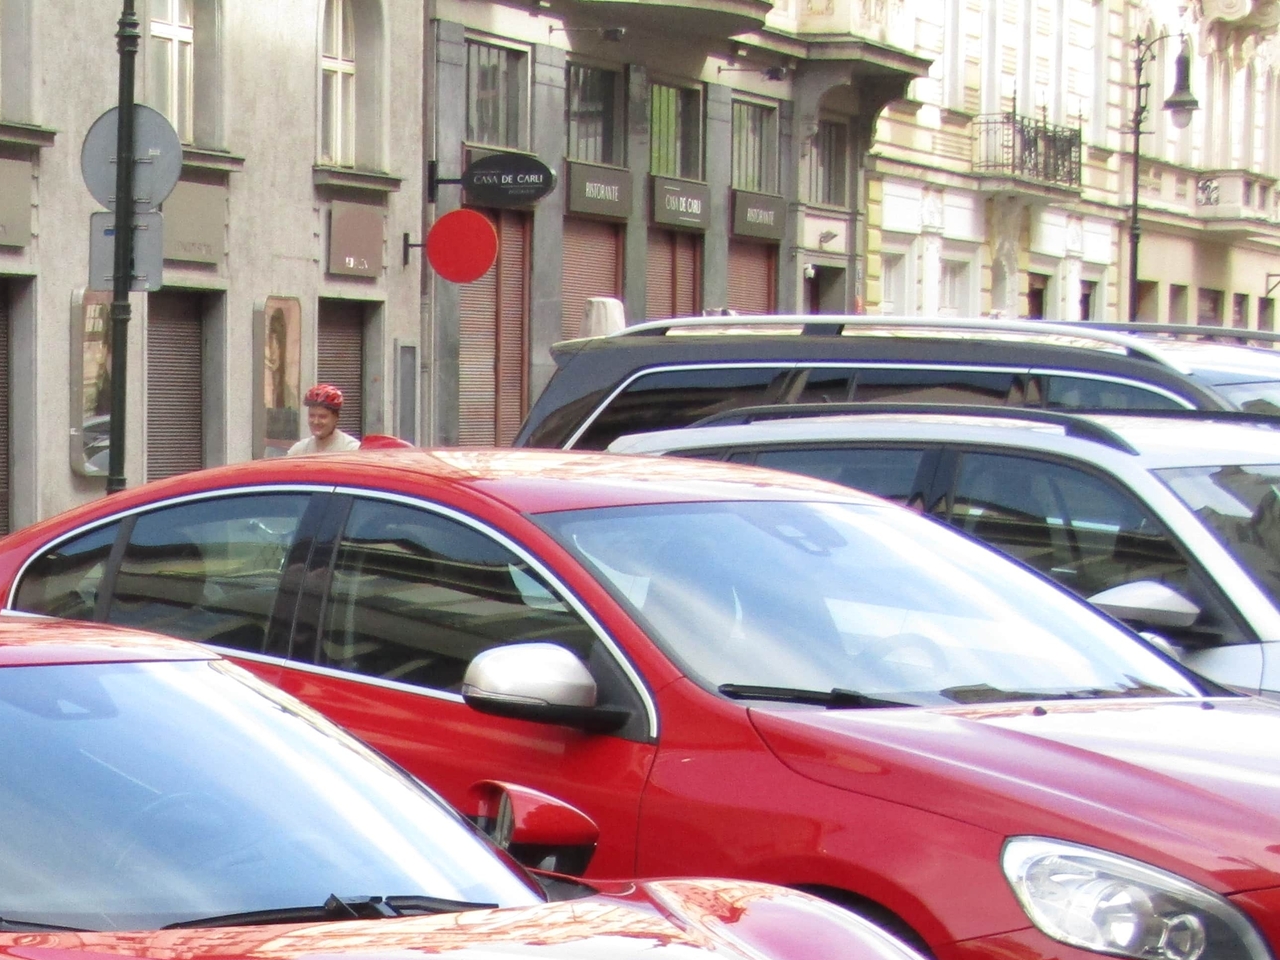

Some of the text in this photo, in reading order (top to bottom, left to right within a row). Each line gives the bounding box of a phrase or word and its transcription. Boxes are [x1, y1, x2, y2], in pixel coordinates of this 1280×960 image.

[473, 174, 543, 184] CASA DE CARLI
[585, 182, 619, 201] RISTORANTE
[665, 194, 678, 210] CASA
[679, 196, 687, 212] DE
[747, 207, 774, 226] RISTORANTE
